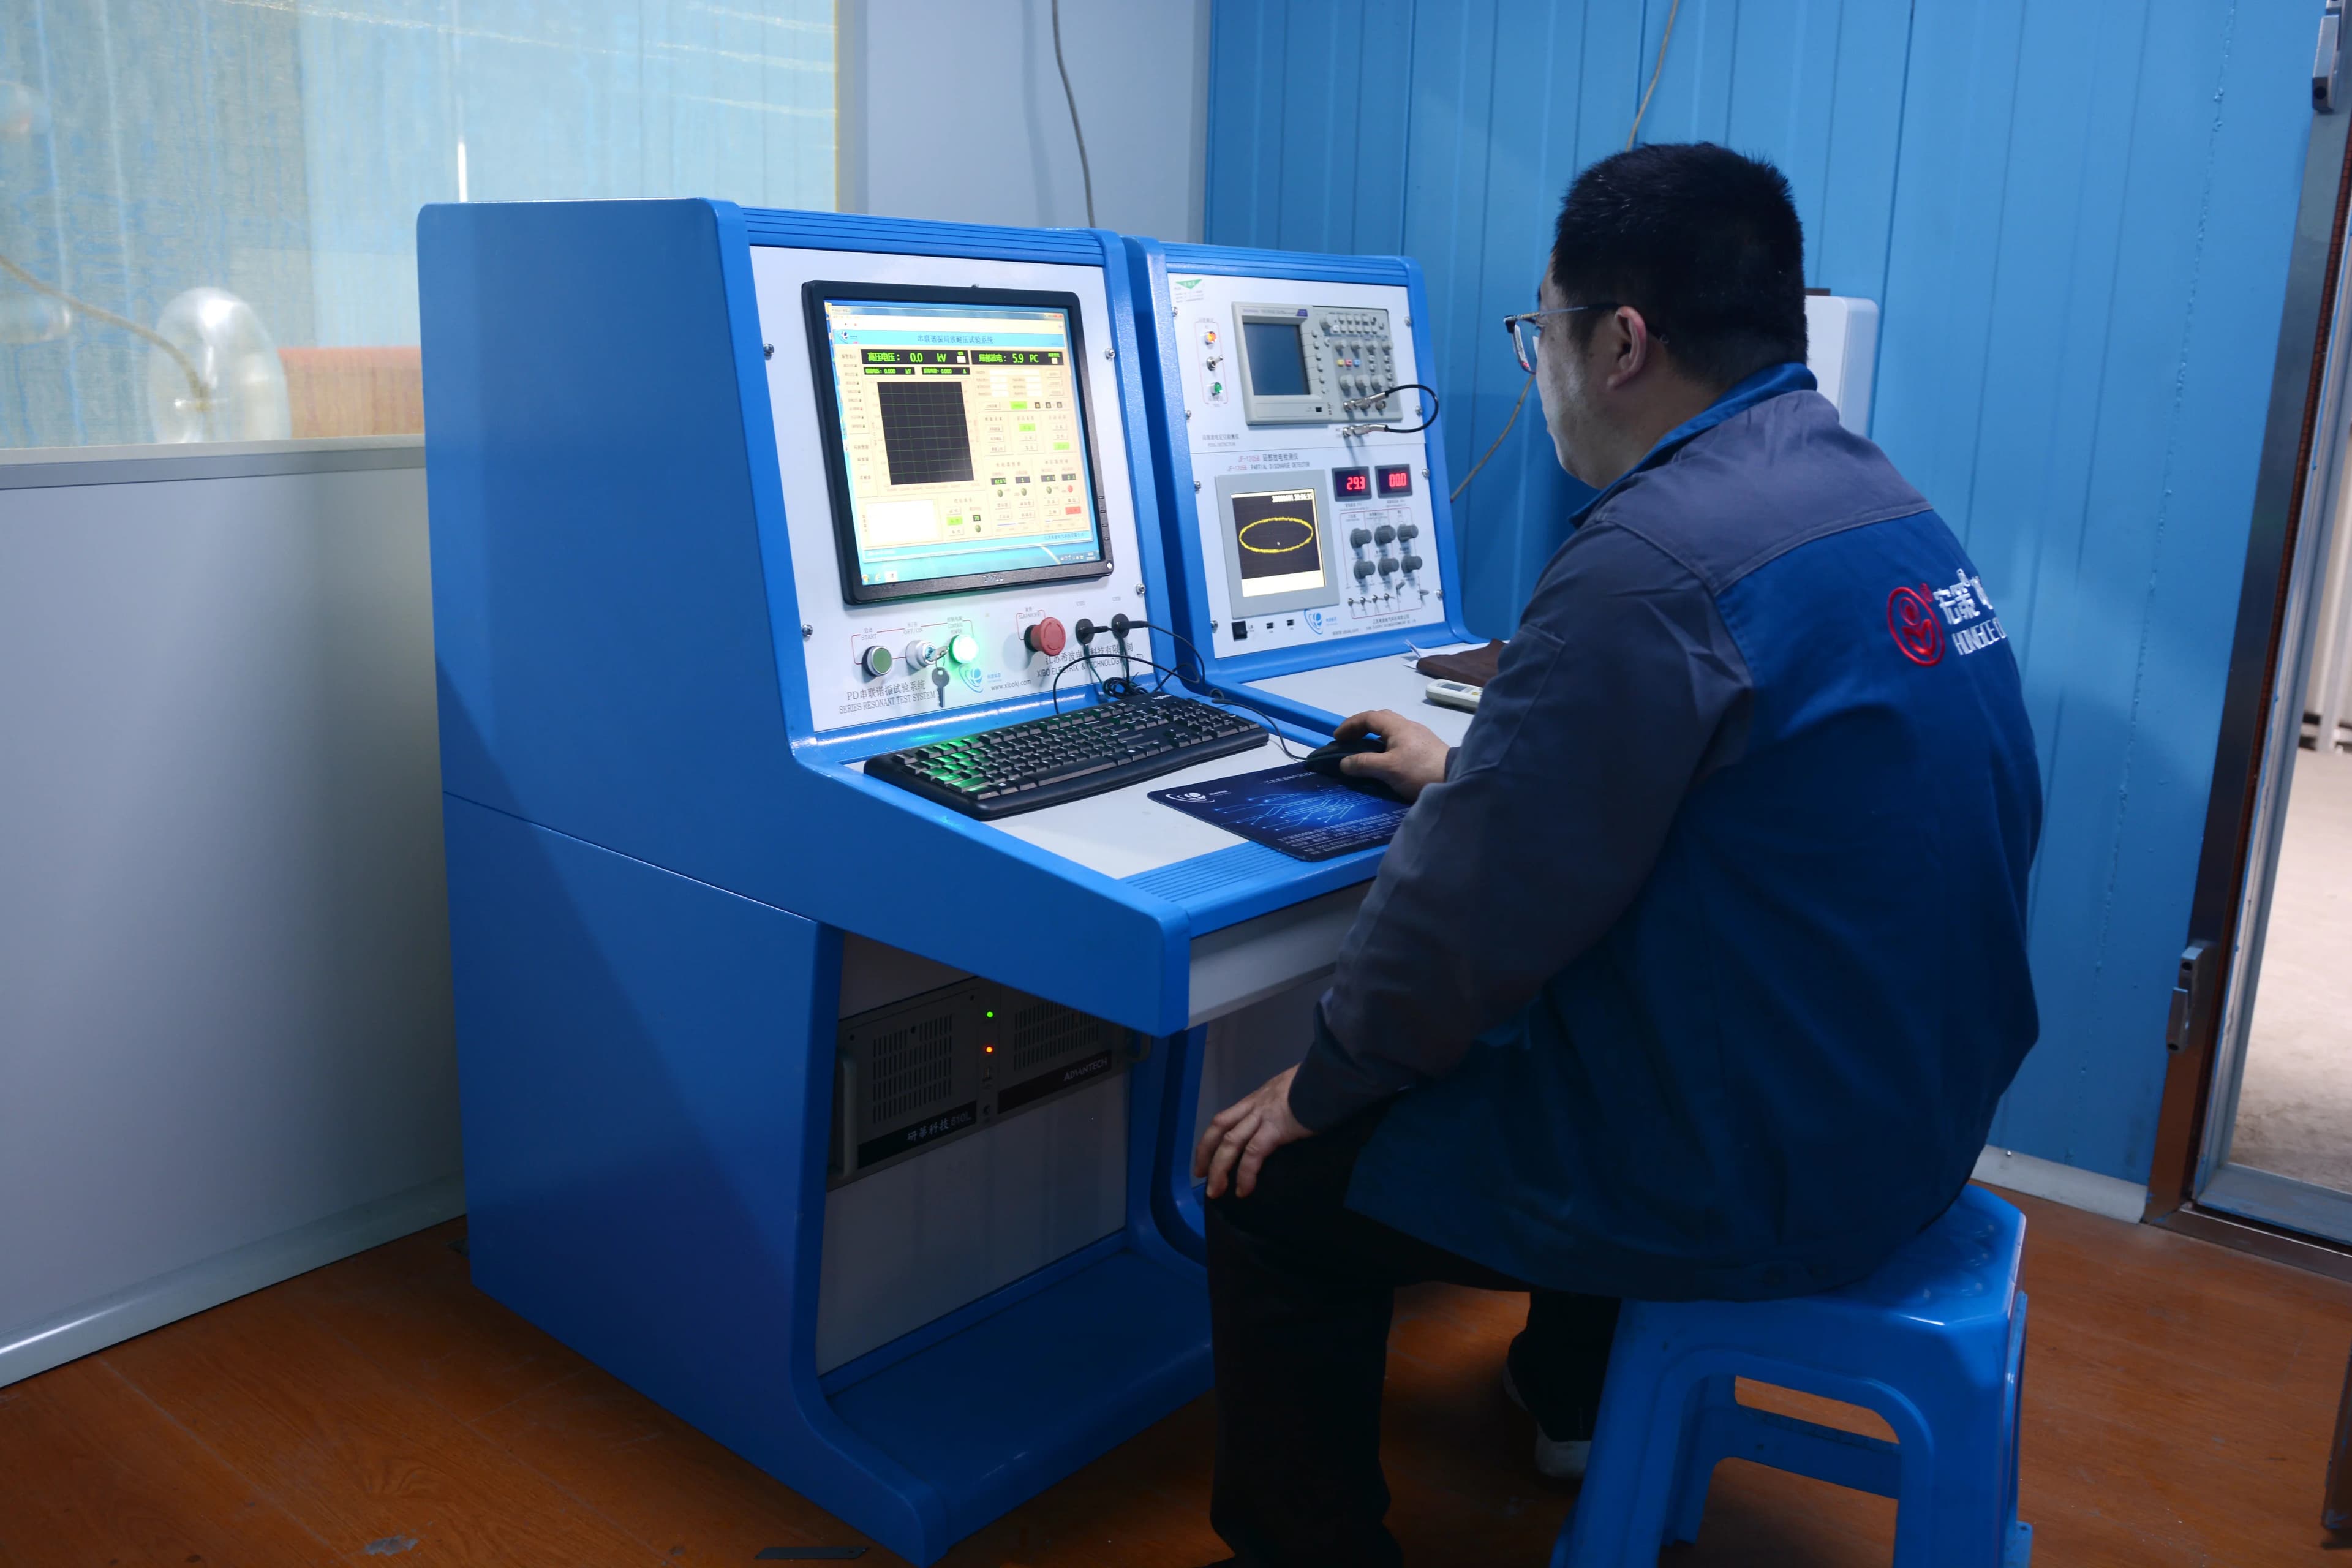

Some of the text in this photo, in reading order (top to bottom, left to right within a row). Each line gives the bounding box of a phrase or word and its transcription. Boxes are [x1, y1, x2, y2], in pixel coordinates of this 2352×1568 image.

[910, 352, 924, 363] 0.0
[1012, 353, 1025, 363] 5.9
[1029, 354, 1039, 363] PC
[1045, 642, 1133, 665] 江苏希波电科技有限司
[1036, 668, 1050, 679] XIBO
[846, 680, 926, 700] PD串联谐振试验系统
[839, 690, 936, 714] SERIES RESONANT TEST SYSTEM
[1063, 1057, 1108, 1082] ADVANTECH
